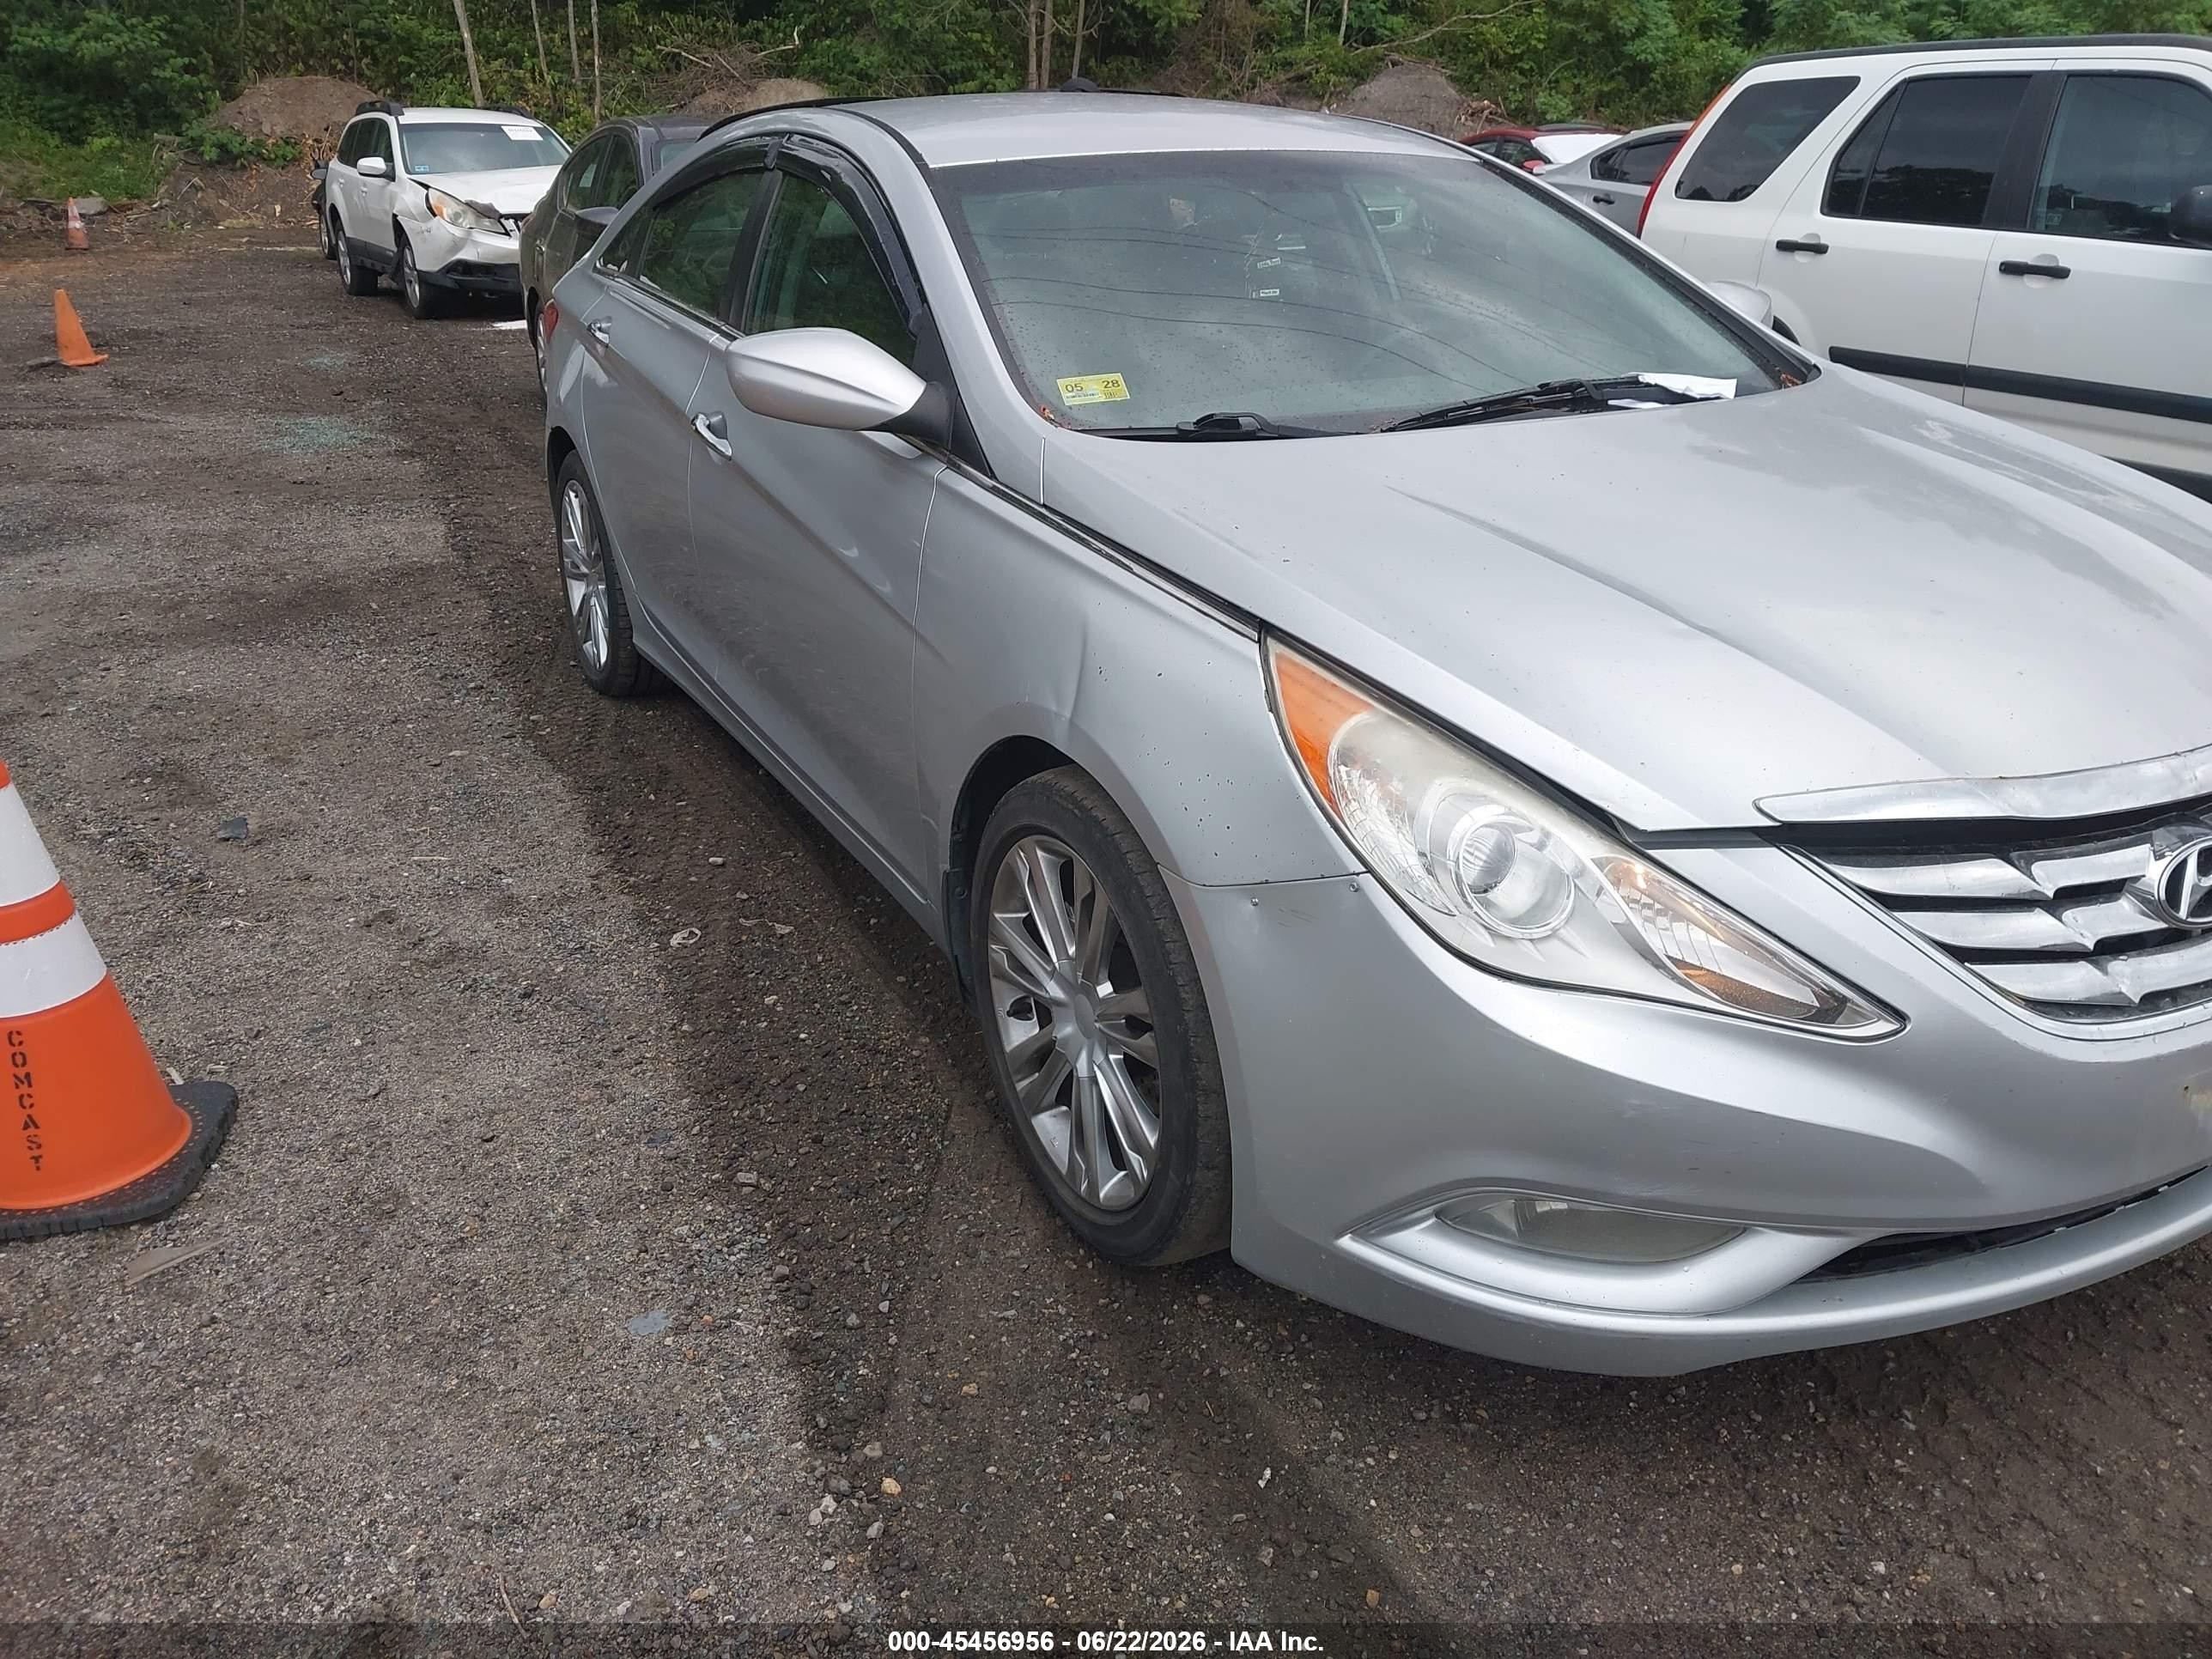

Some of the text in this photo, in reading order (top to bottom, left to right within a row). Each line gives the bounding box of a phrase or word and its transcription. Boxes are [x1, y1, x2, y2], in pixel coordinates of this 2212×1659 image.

[1065, 380, 1121, 392] 05 28
[7, 1030, 43, 1170] COMCAST
